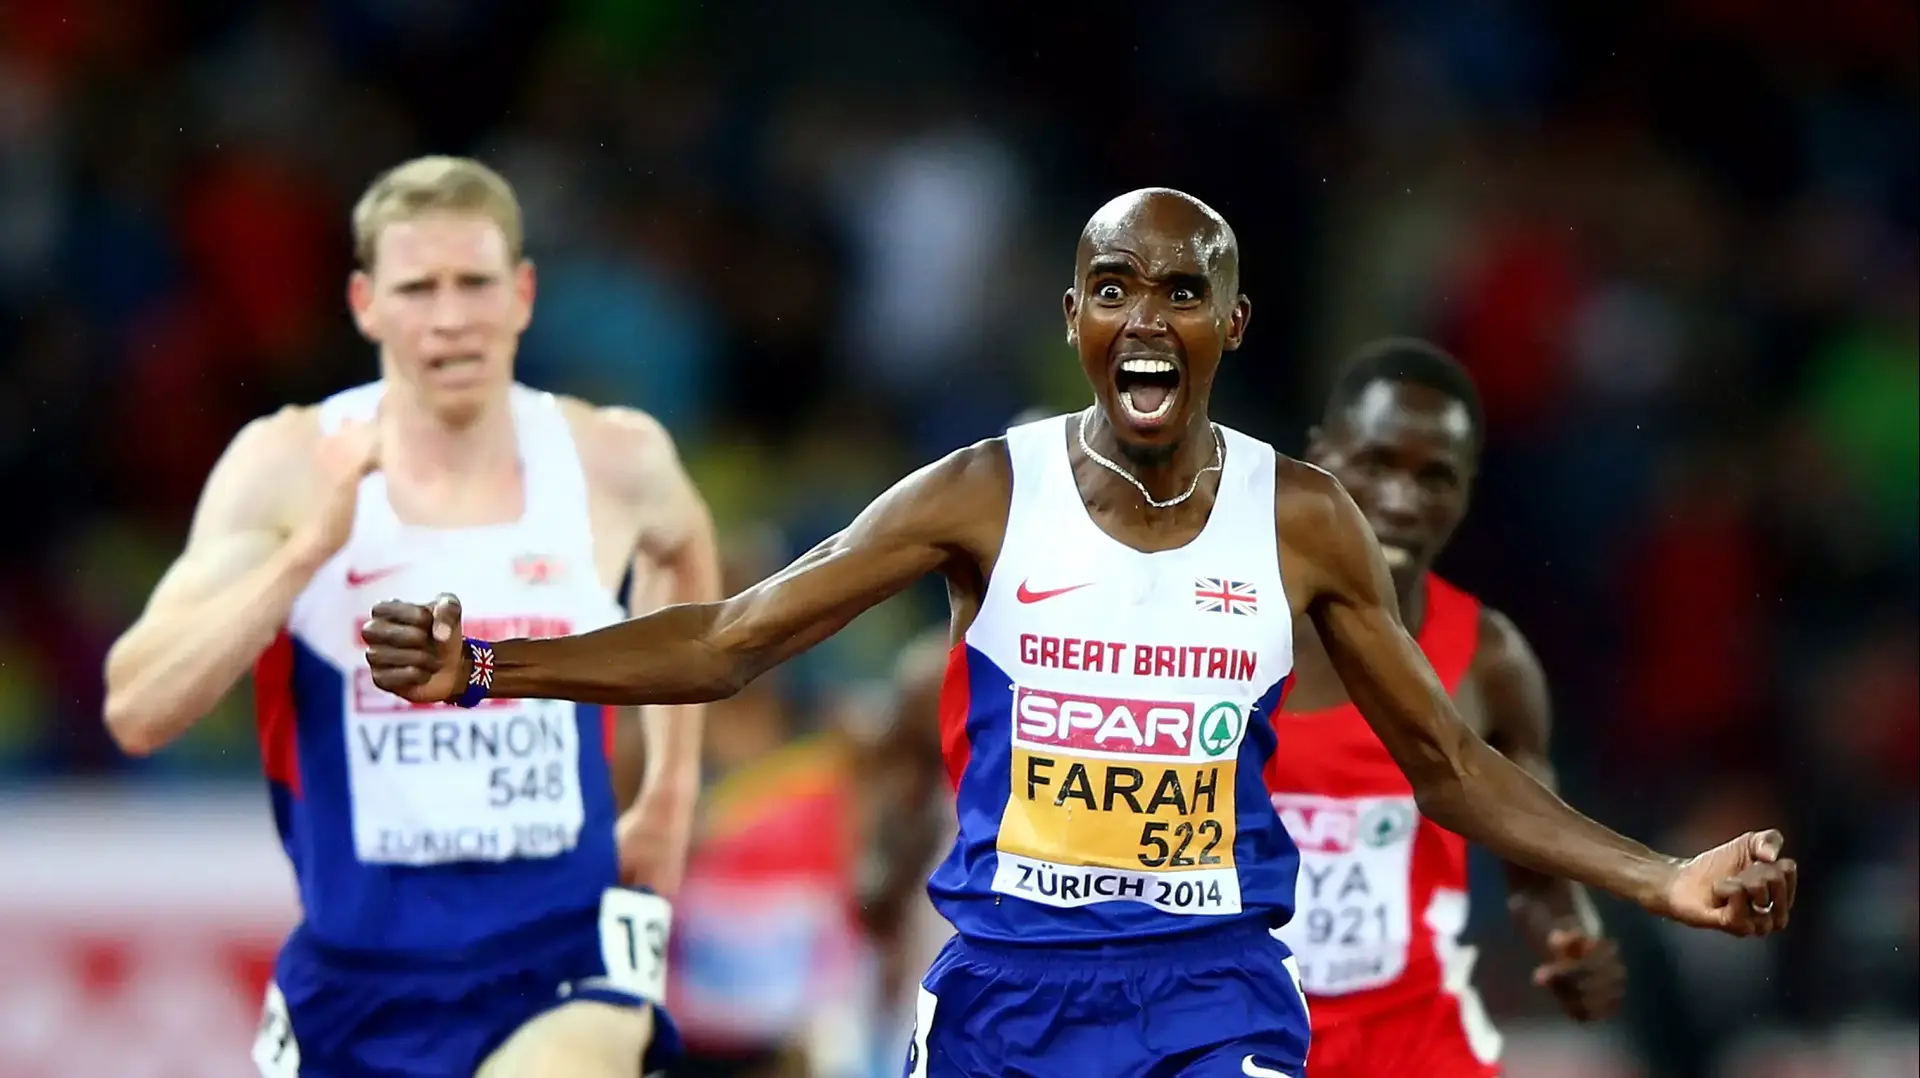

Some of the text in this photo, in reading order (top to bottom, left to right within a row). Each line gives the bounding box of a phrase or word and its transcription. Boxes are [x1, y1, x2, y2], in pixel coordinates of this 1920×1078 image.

[1020, 633, 1257, 682] GREAT BRITAIN
[358, 716, 565, 765] VERNON
[1020, 695, 1190, 749] SPAR
[489, 760, 565, 808] 548
[1027, 756, 1218, 816] FARAH
[1137, 819, 1223, 867] 522
[1014, 863, 1222, 908] ZÜRICH 2014
